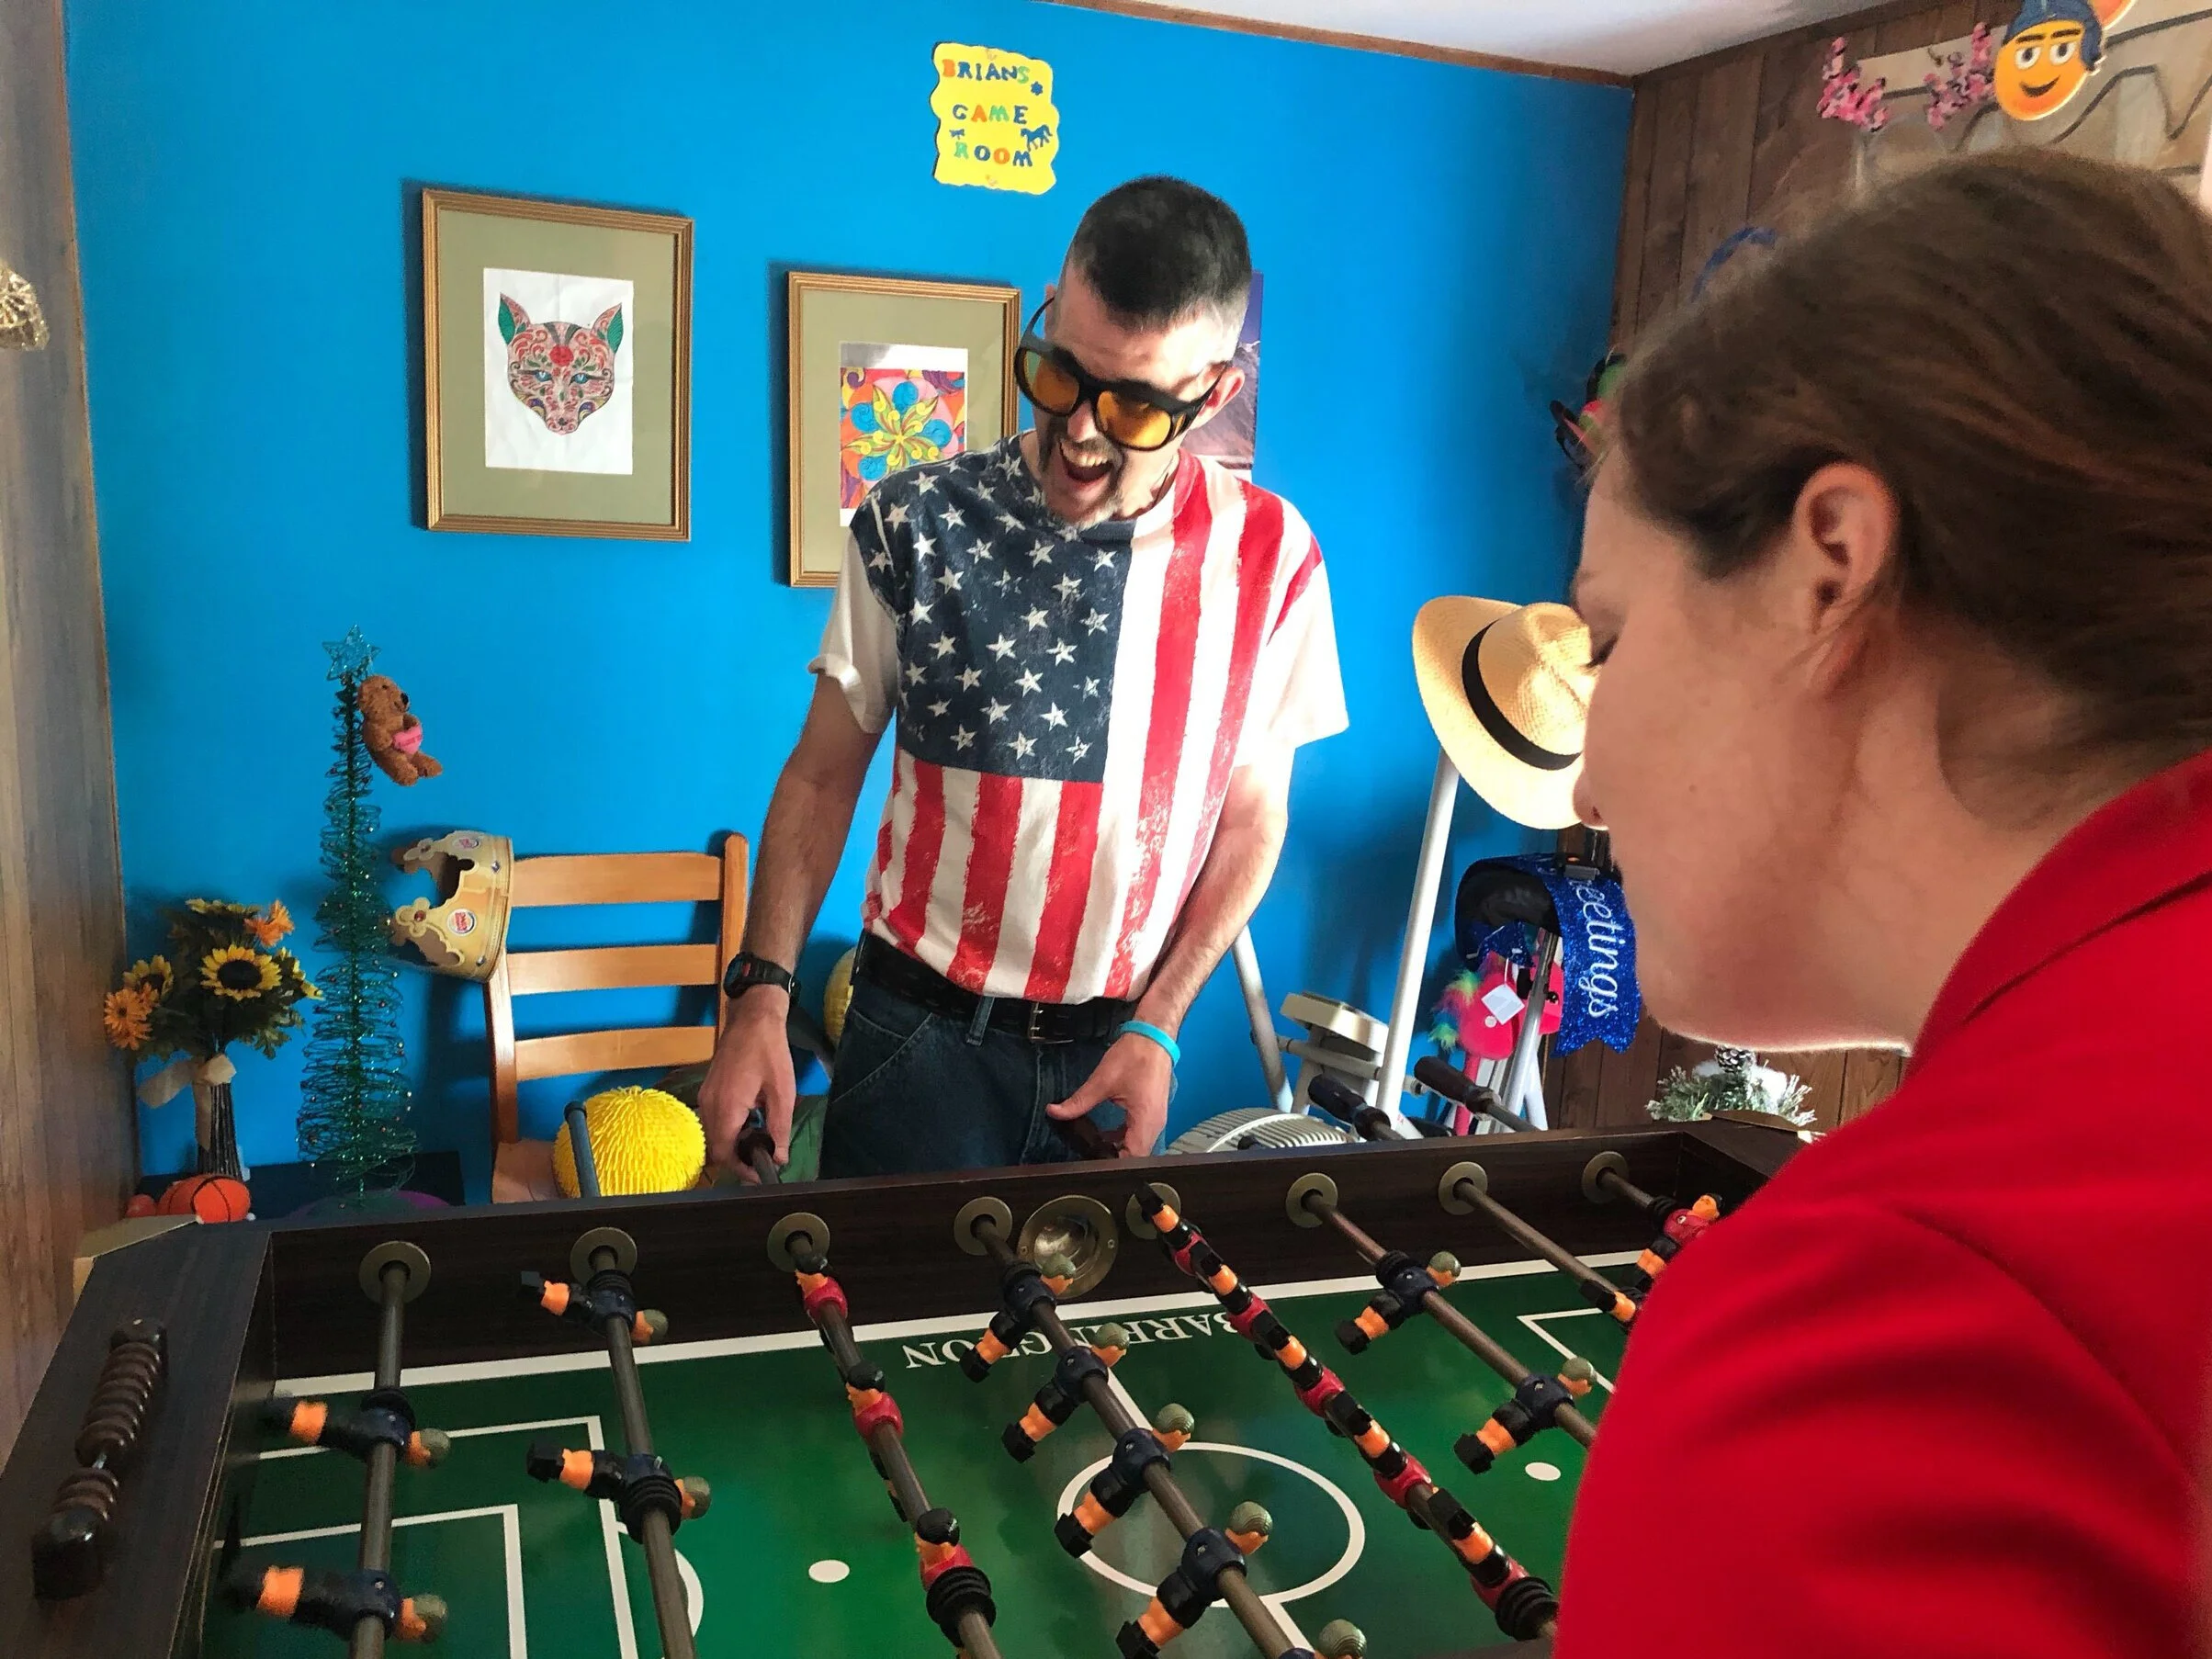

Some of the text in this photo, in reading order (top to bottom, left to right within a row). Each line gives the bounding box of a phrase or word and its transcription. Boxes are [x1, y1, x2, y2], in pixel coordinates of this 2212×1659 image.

[942, 59, 1030, 84] BRIANS
[953, 104, 1028, 124] GAME
[954, 141, 1033, 167] ROOM
